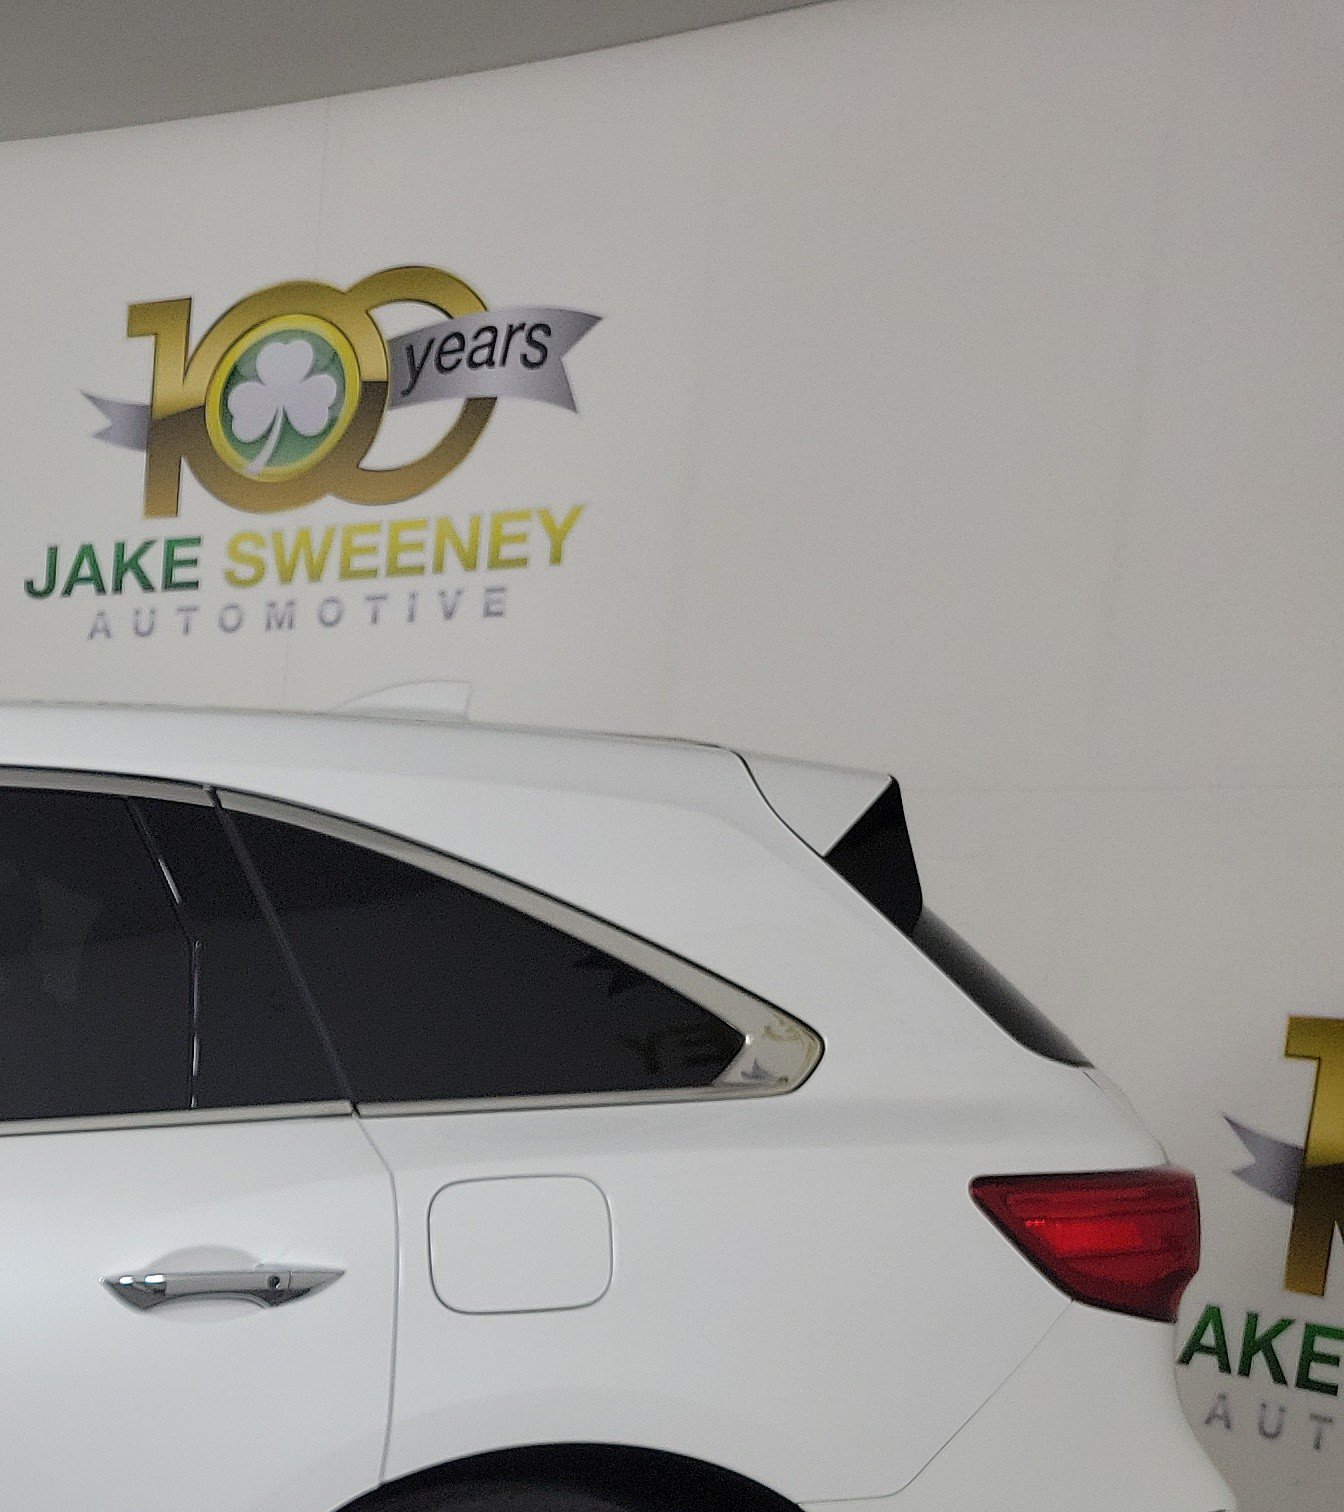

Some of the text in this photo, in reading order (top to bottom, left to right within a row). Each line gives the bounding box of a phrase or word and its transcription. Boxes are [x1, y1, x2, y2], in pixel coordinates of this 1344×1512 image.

[401, 322, 550, 396] years
[24, 504, 583, 599] JAKE SWEENEY
[87, 587, 507, 640] AUTOMOTIVE
[1176, 1304, 1341, 1396] AKE
